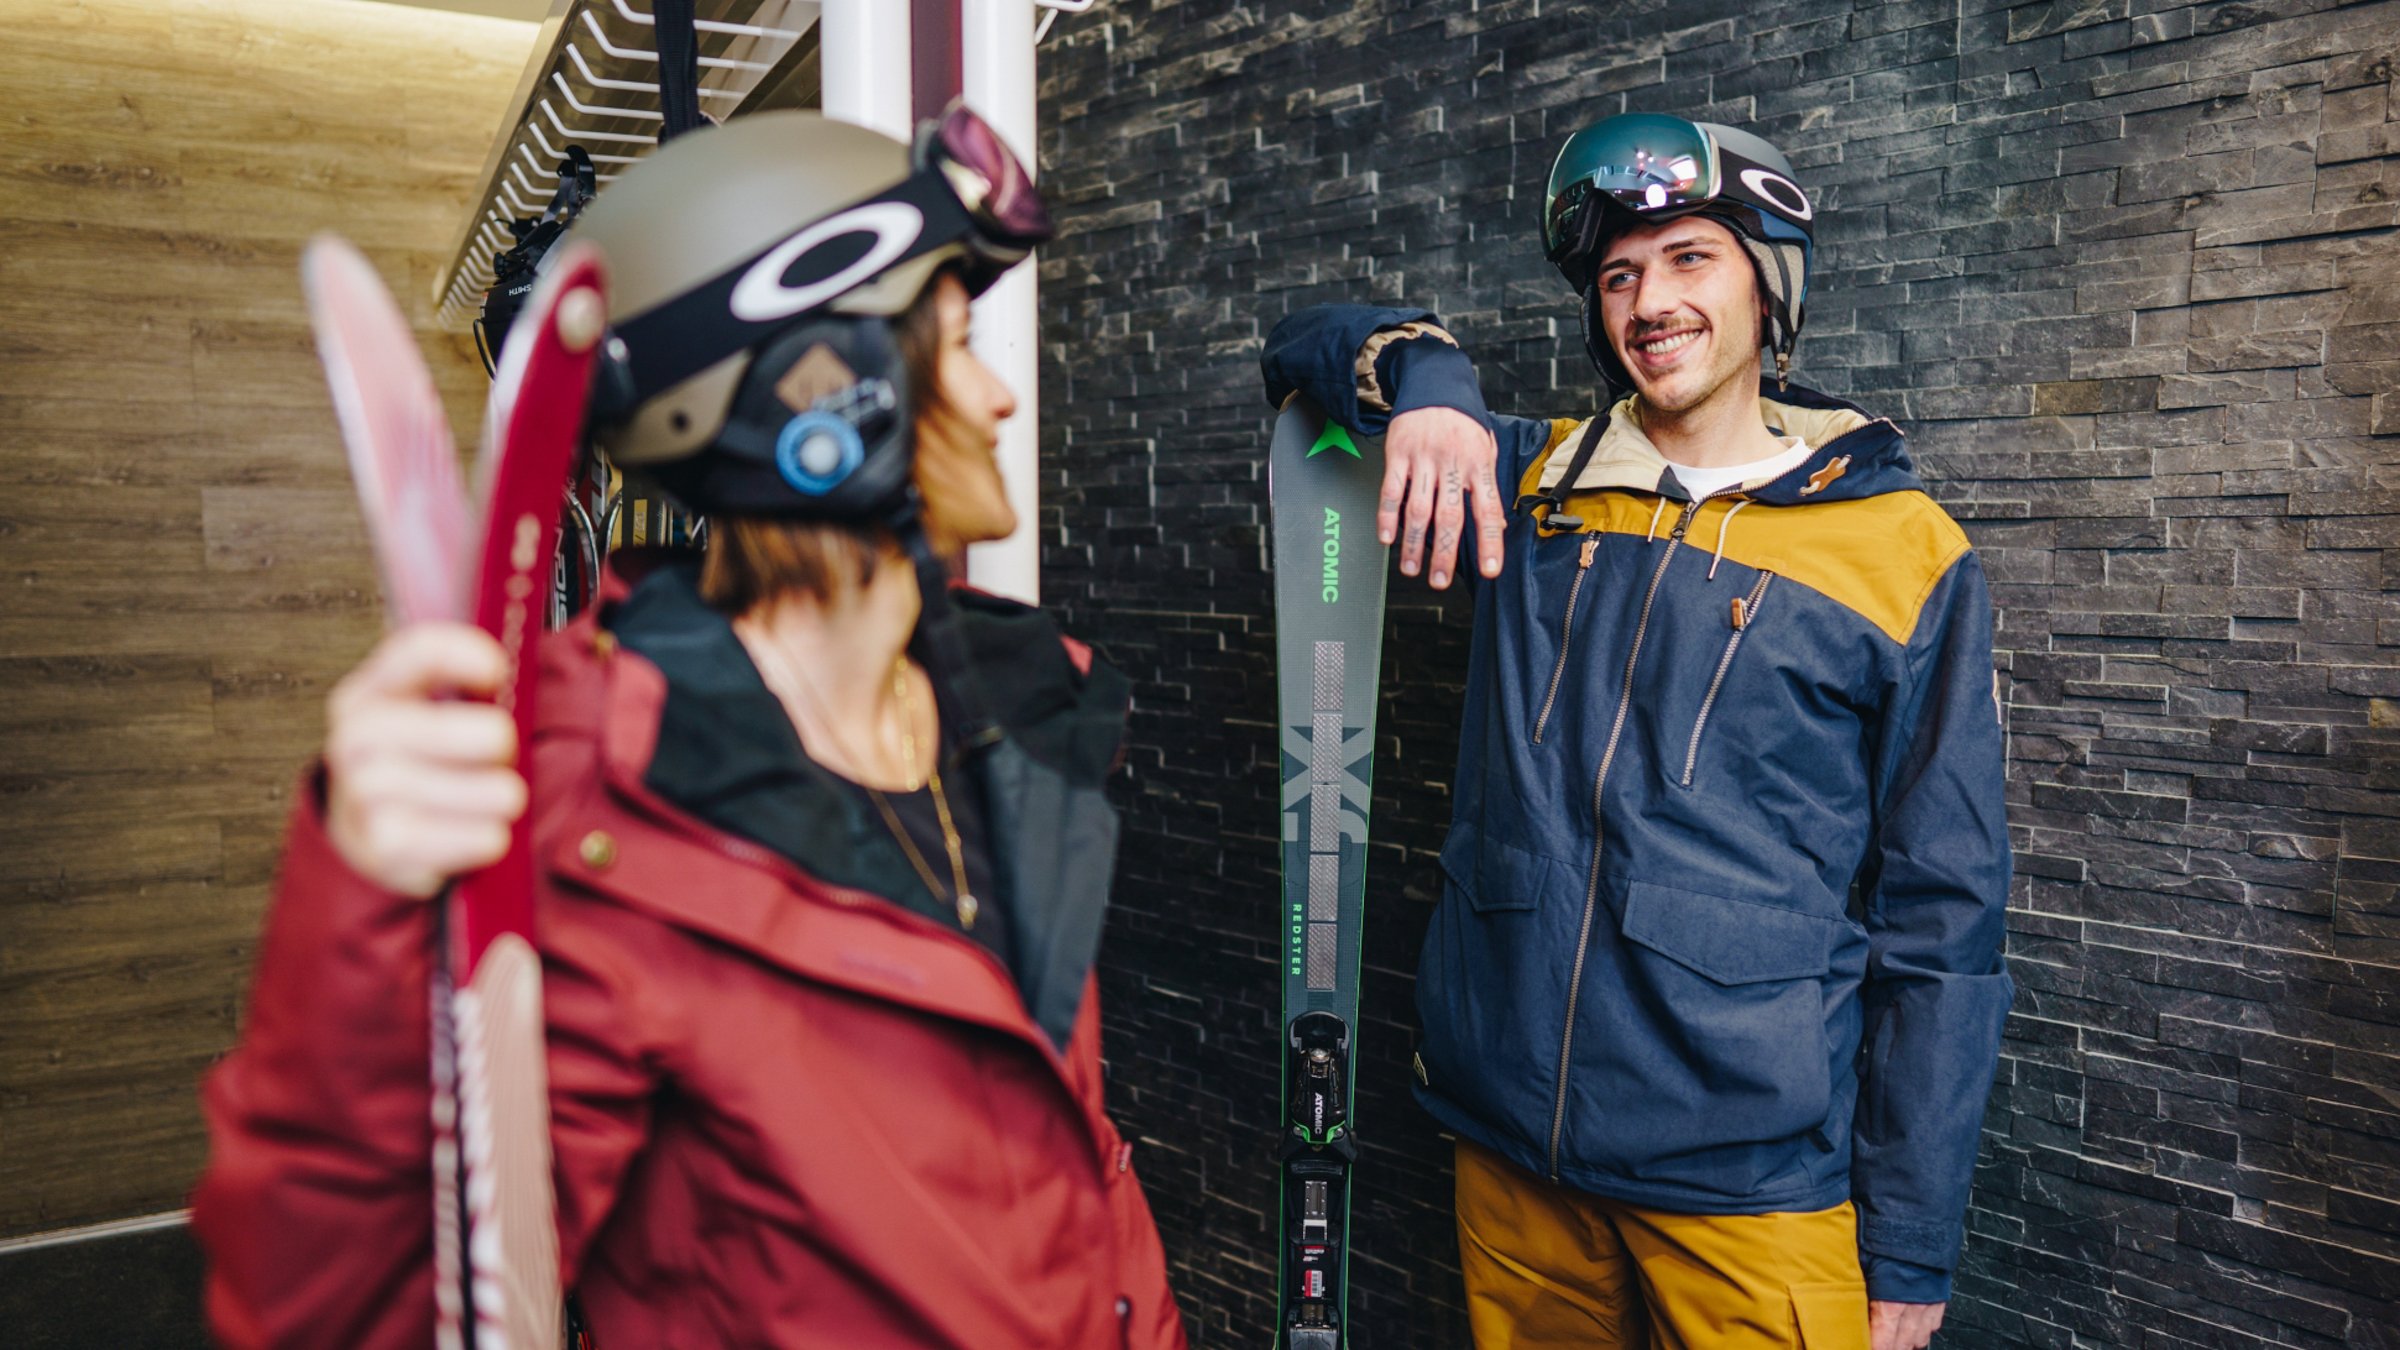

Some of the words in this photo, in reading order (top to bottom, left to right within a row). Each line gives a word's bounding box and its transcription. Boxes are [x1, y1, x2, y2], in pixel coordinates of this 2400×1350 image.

[508, 283, 532, 297] SMITH
[1321, 506, 1341, 604] ATOMIC
[1291, 903, 1303, 976] REDSTER
[1314, 1092, 1324, 1135] ATOMIC
